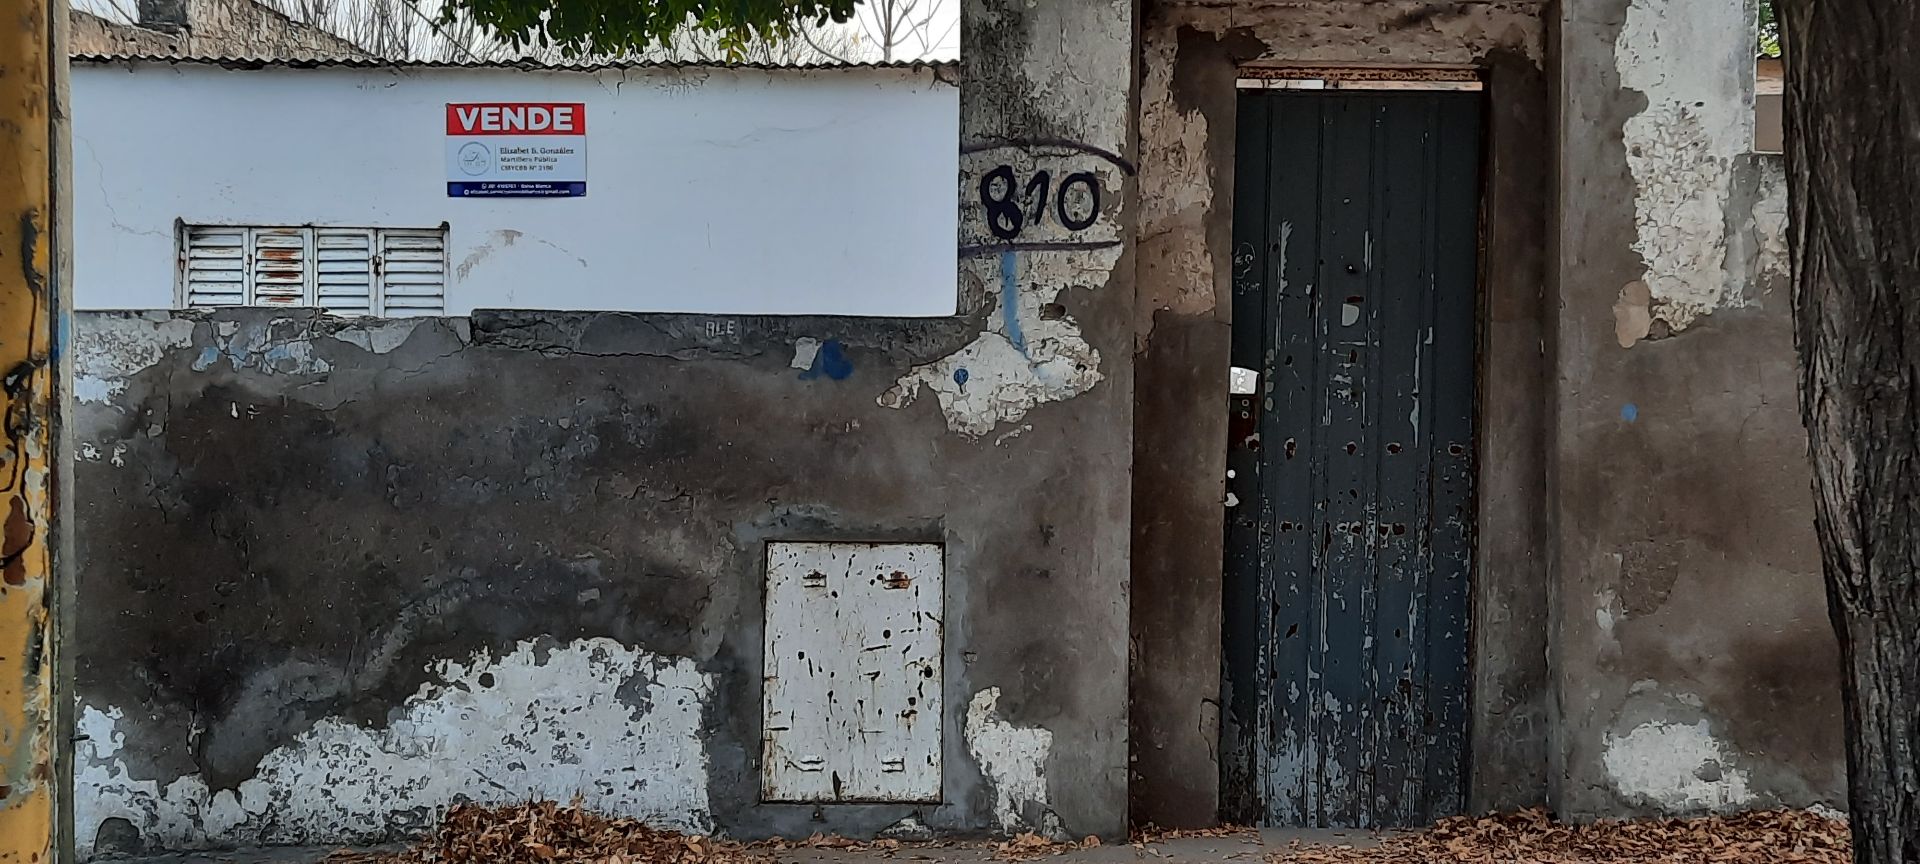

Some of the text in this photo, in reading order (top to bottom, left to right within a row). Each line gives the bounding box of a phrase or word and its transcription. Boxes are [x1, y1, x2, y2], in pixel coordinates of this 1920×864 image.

[456, 107, 573, 131] VENDE
[980, 165, 1099, 239] 810
[705, 320, 736, 337] ALE
